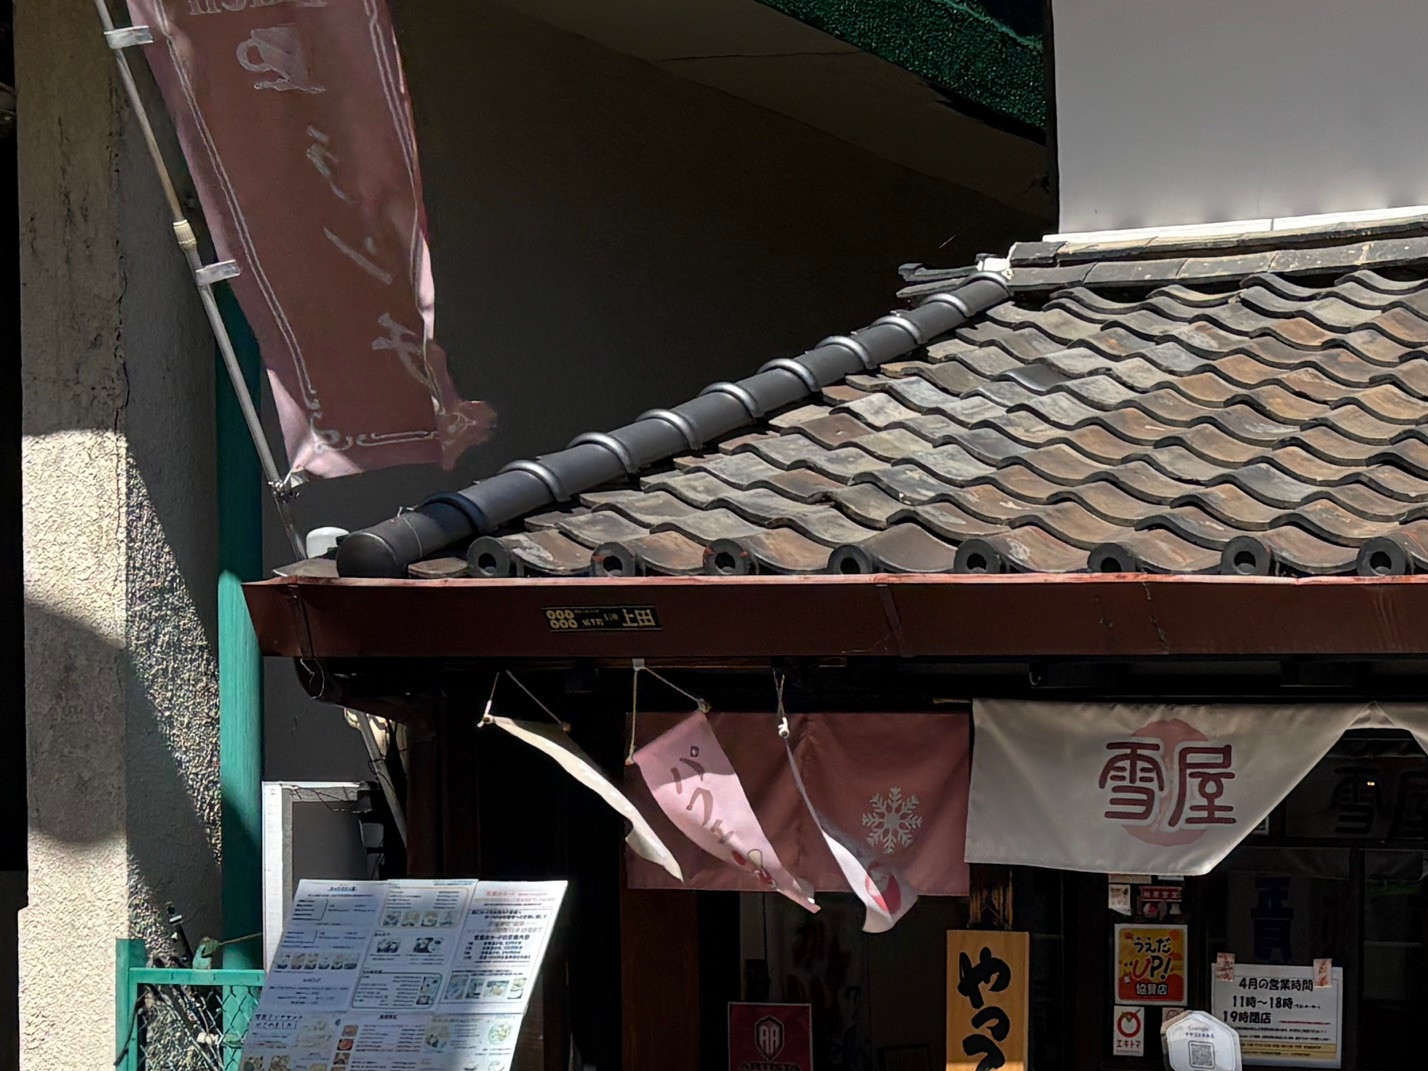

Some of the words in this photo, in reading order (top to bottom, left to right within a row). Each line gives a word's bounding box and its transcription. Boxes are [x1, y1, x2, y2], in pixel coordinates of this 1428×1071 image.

[622, 608, 656, 627] 上田
[1097, 741, 1237, 826] 雪屋
[1133, 936, 1172, 954] うえだ
[1132, 954, 1172, 981] UP!
[1238, 977, 1314, 992] 4月の営業時間
[1223, 1011, 1272, 1024] 19時閉店
